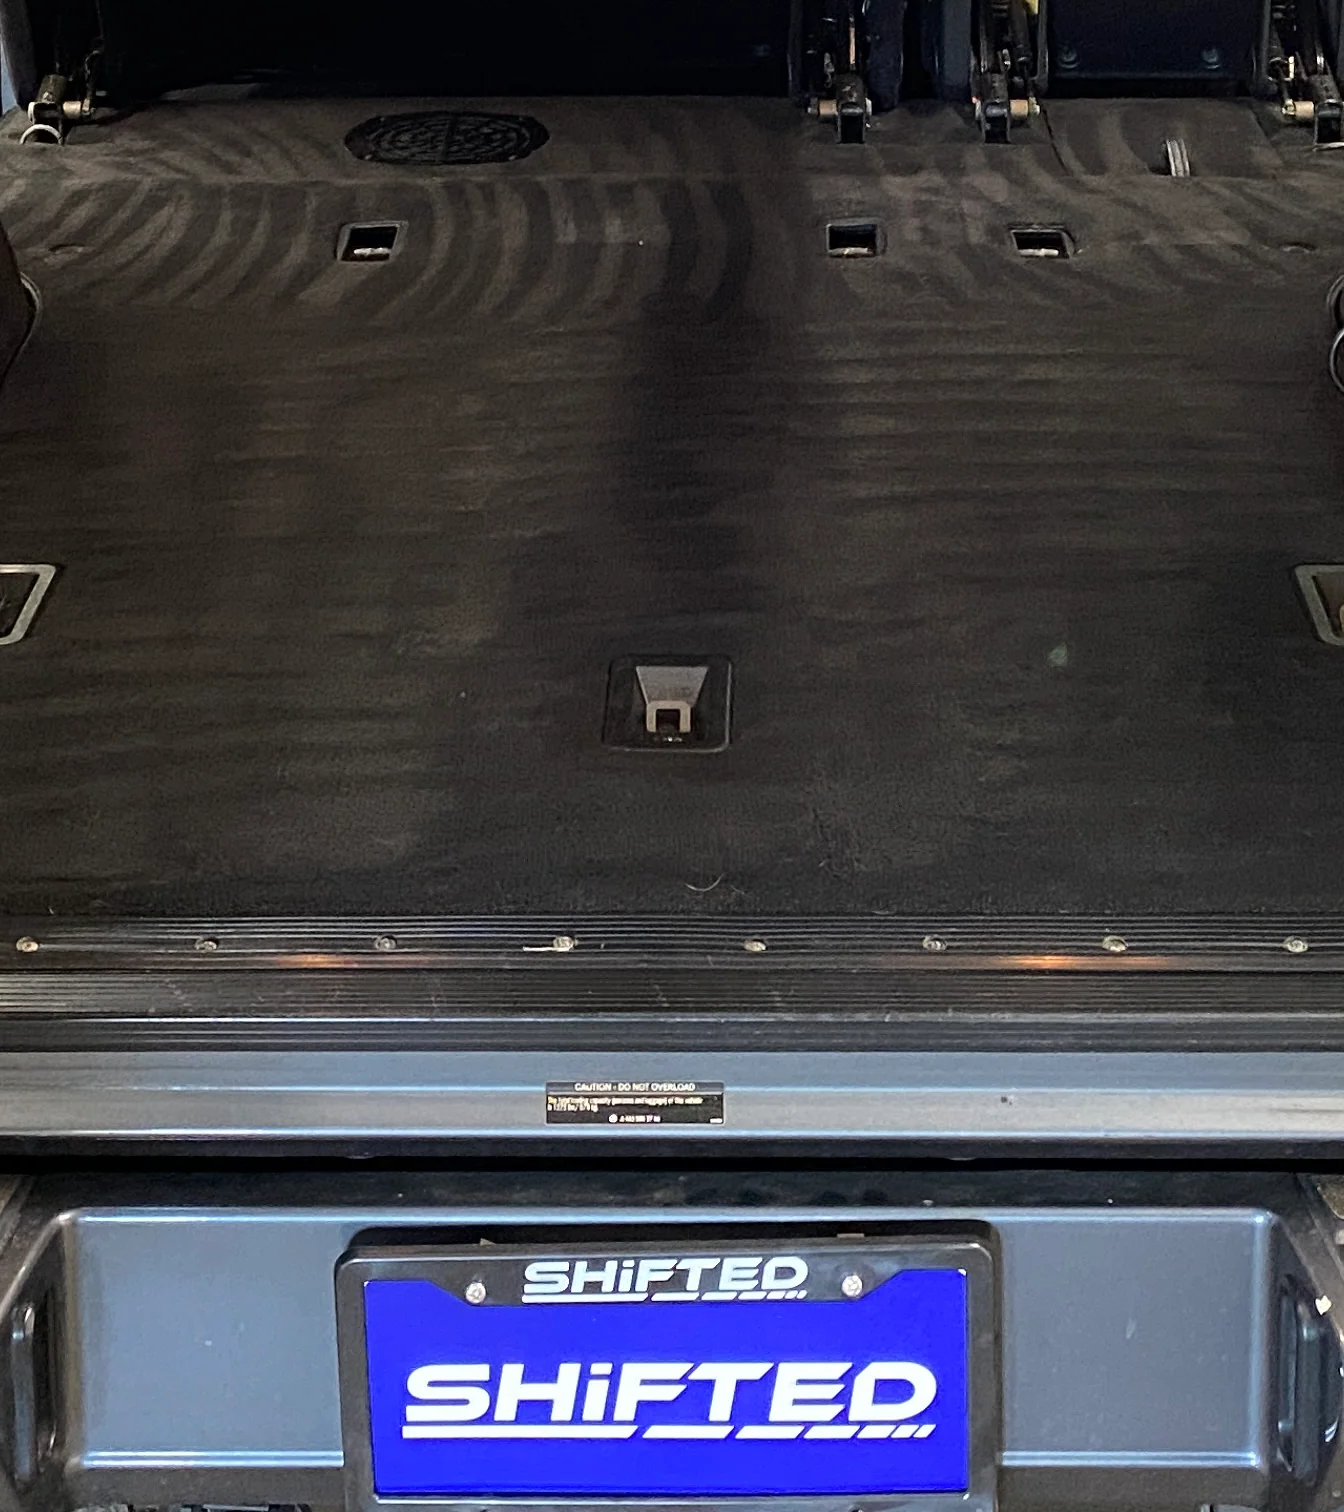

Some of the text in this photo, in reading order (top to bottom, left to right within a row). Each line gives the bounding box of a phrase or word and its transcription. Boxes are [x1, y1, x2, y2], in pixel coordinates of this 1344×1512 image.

[574, 1082, 612, 1092] CAUTION
[618, 1082, 631, 1092] DO
[632, 1082, 649, 1092] NOT
[650, 1082, 696, 1092] OVERLOAD
